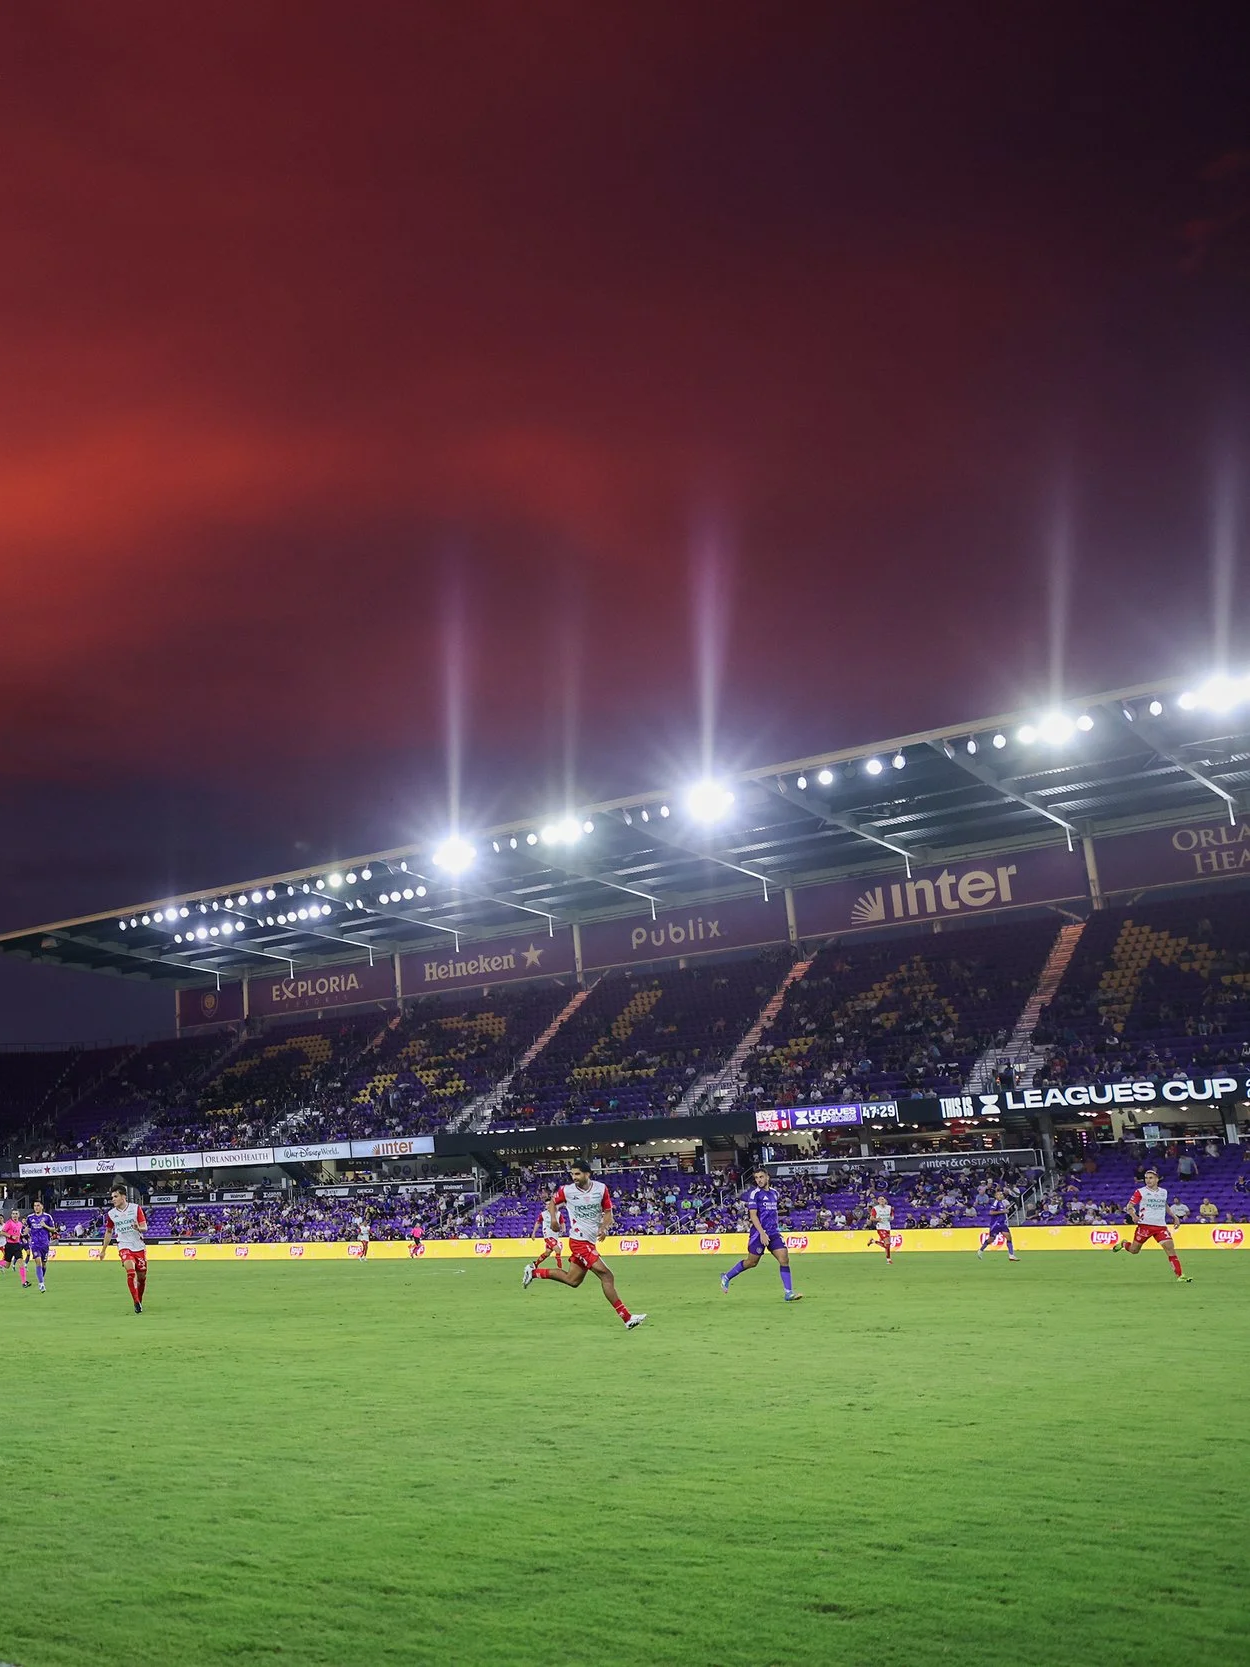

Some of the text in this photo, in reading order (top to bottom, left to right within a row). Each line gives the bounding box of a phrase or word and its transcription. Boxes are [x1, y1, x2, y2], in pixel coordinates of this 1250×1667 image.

[1172, 823, 1250, 851] ORLA
[890, 865, 1017, 918] inter
[631, 917, 721, 950] Publix
[424, 954, 516, 982] Heineken
[1005, 1081, 1157, 1110] LEAGUES
[1161, 1078, 1238, 1101] CUP
[808, 1107, 857, 1118] LEAGUES
[862, 1105, 896, 1119] 47:29
[809, 1114, 832, 1124] CUP
[381, 1141, 414, 1155] inter
[151, 1156, 186, 1169] Publix
[205, 1152, 269, 1164] ORLANDO HEALTH
[52, 1165, 73, 1174] SILVER
[96, 1160, 115, 1172] Ford
[1092, 1231, 1117, 1243] Lay's
[1215, 1230, 1242, 1242] Lay's
[621, 1240, 639, 1250] Lay's
[702, 1239, 720, 1249] Lay's
[788, 1237, 807, 1248] Lay's
